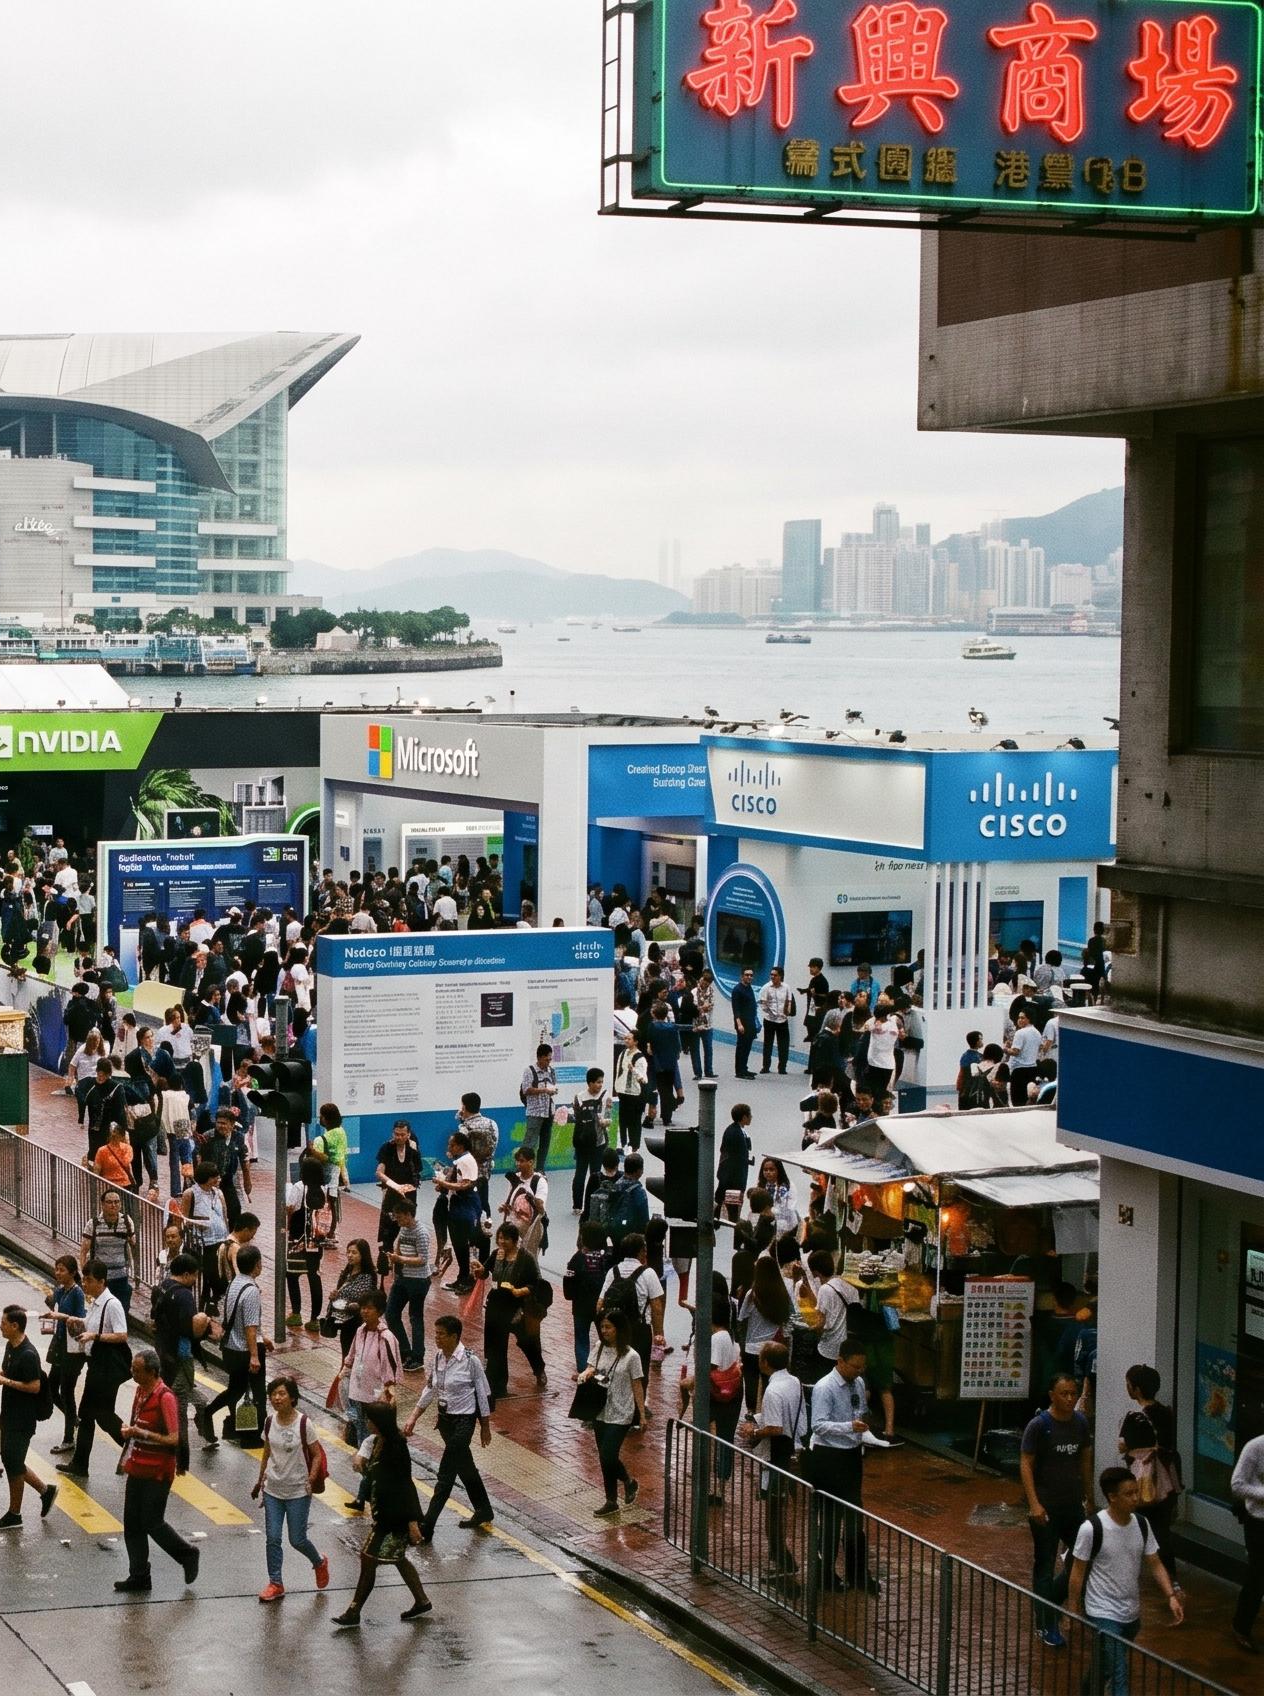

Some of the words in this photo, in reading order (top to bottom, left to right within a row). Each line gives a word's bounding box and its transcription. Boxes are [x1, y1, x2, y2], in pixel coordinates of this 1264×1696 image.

[685, 0, 1239, 148] 新興商場
[397, 735, 480, 778] Microsoft
[732, 794, 777, 815] CISCO
[979, 813, 1068, 837] CISCO
